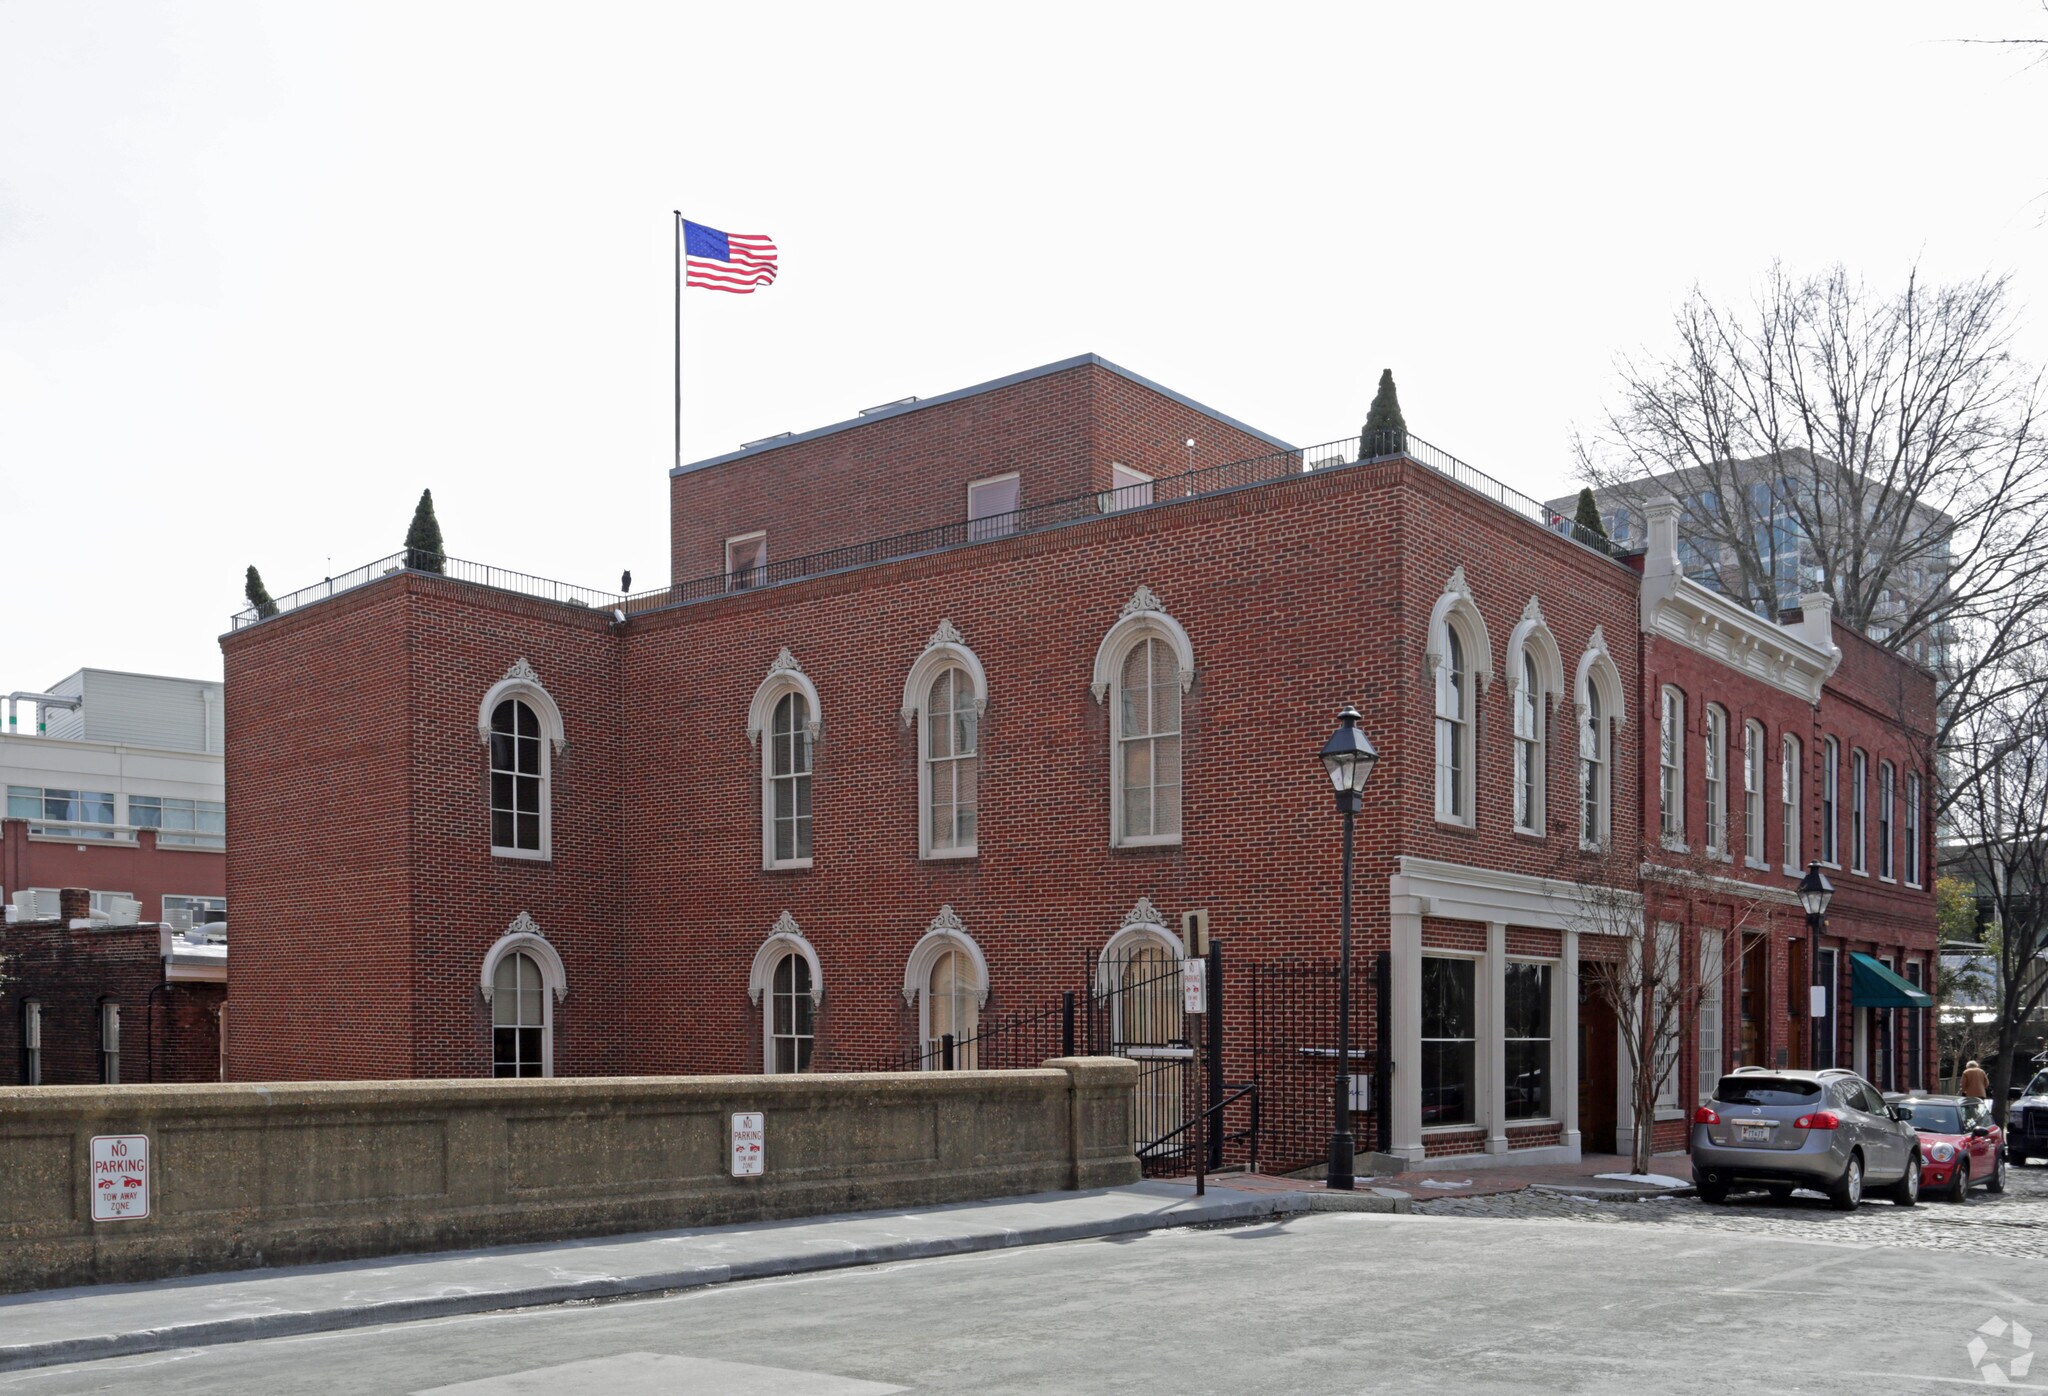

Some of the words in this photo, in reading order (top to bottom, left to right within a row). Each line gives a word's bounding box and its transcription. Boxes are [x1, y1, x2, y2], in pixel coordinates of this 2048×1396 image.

[743, 1119, 752, 1128] NO
[734, 1131, 761, 1140] PARKING
[112, 1144, 127, 1157] NO
[95, 1159, 144, 1173] PARKING
[103, 1193, 117, 1201] TOW
[120, 1192, 137, 1200] AWAY
[111, 1202, 130, 1210] ZONE
